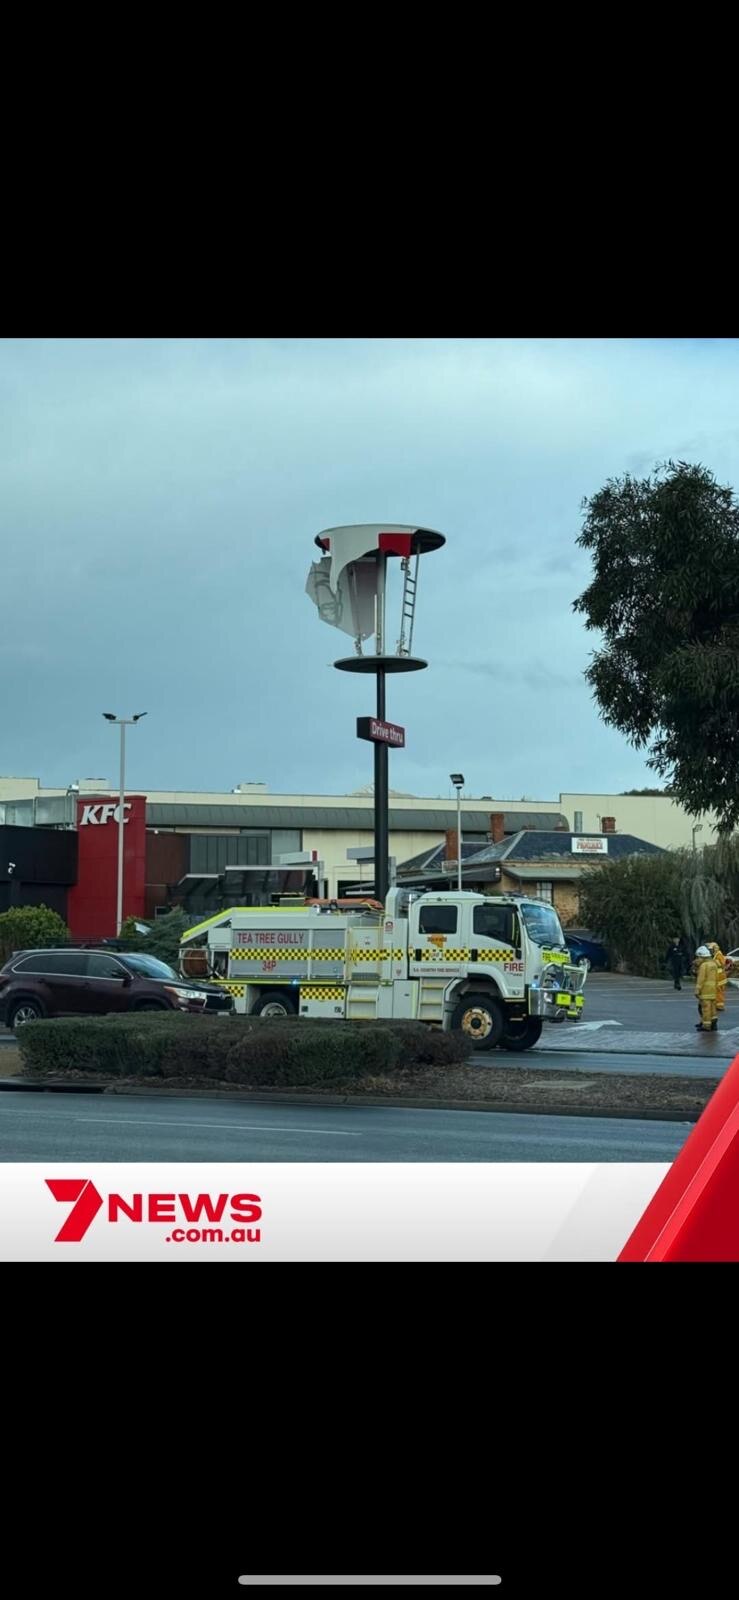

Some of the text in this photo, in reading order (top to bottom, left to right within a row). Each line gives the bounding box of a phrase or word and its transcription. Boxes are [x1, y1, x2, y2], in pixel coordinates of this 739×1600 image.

[373, 721, 403, 743] Drive thru
[80, 803, 132, 825] KFC
[238, 933, 304, 944] TEA TREE GULLY
[262, 960, 277, 972] 34P
[504, 963, 524, 972] FIRE
